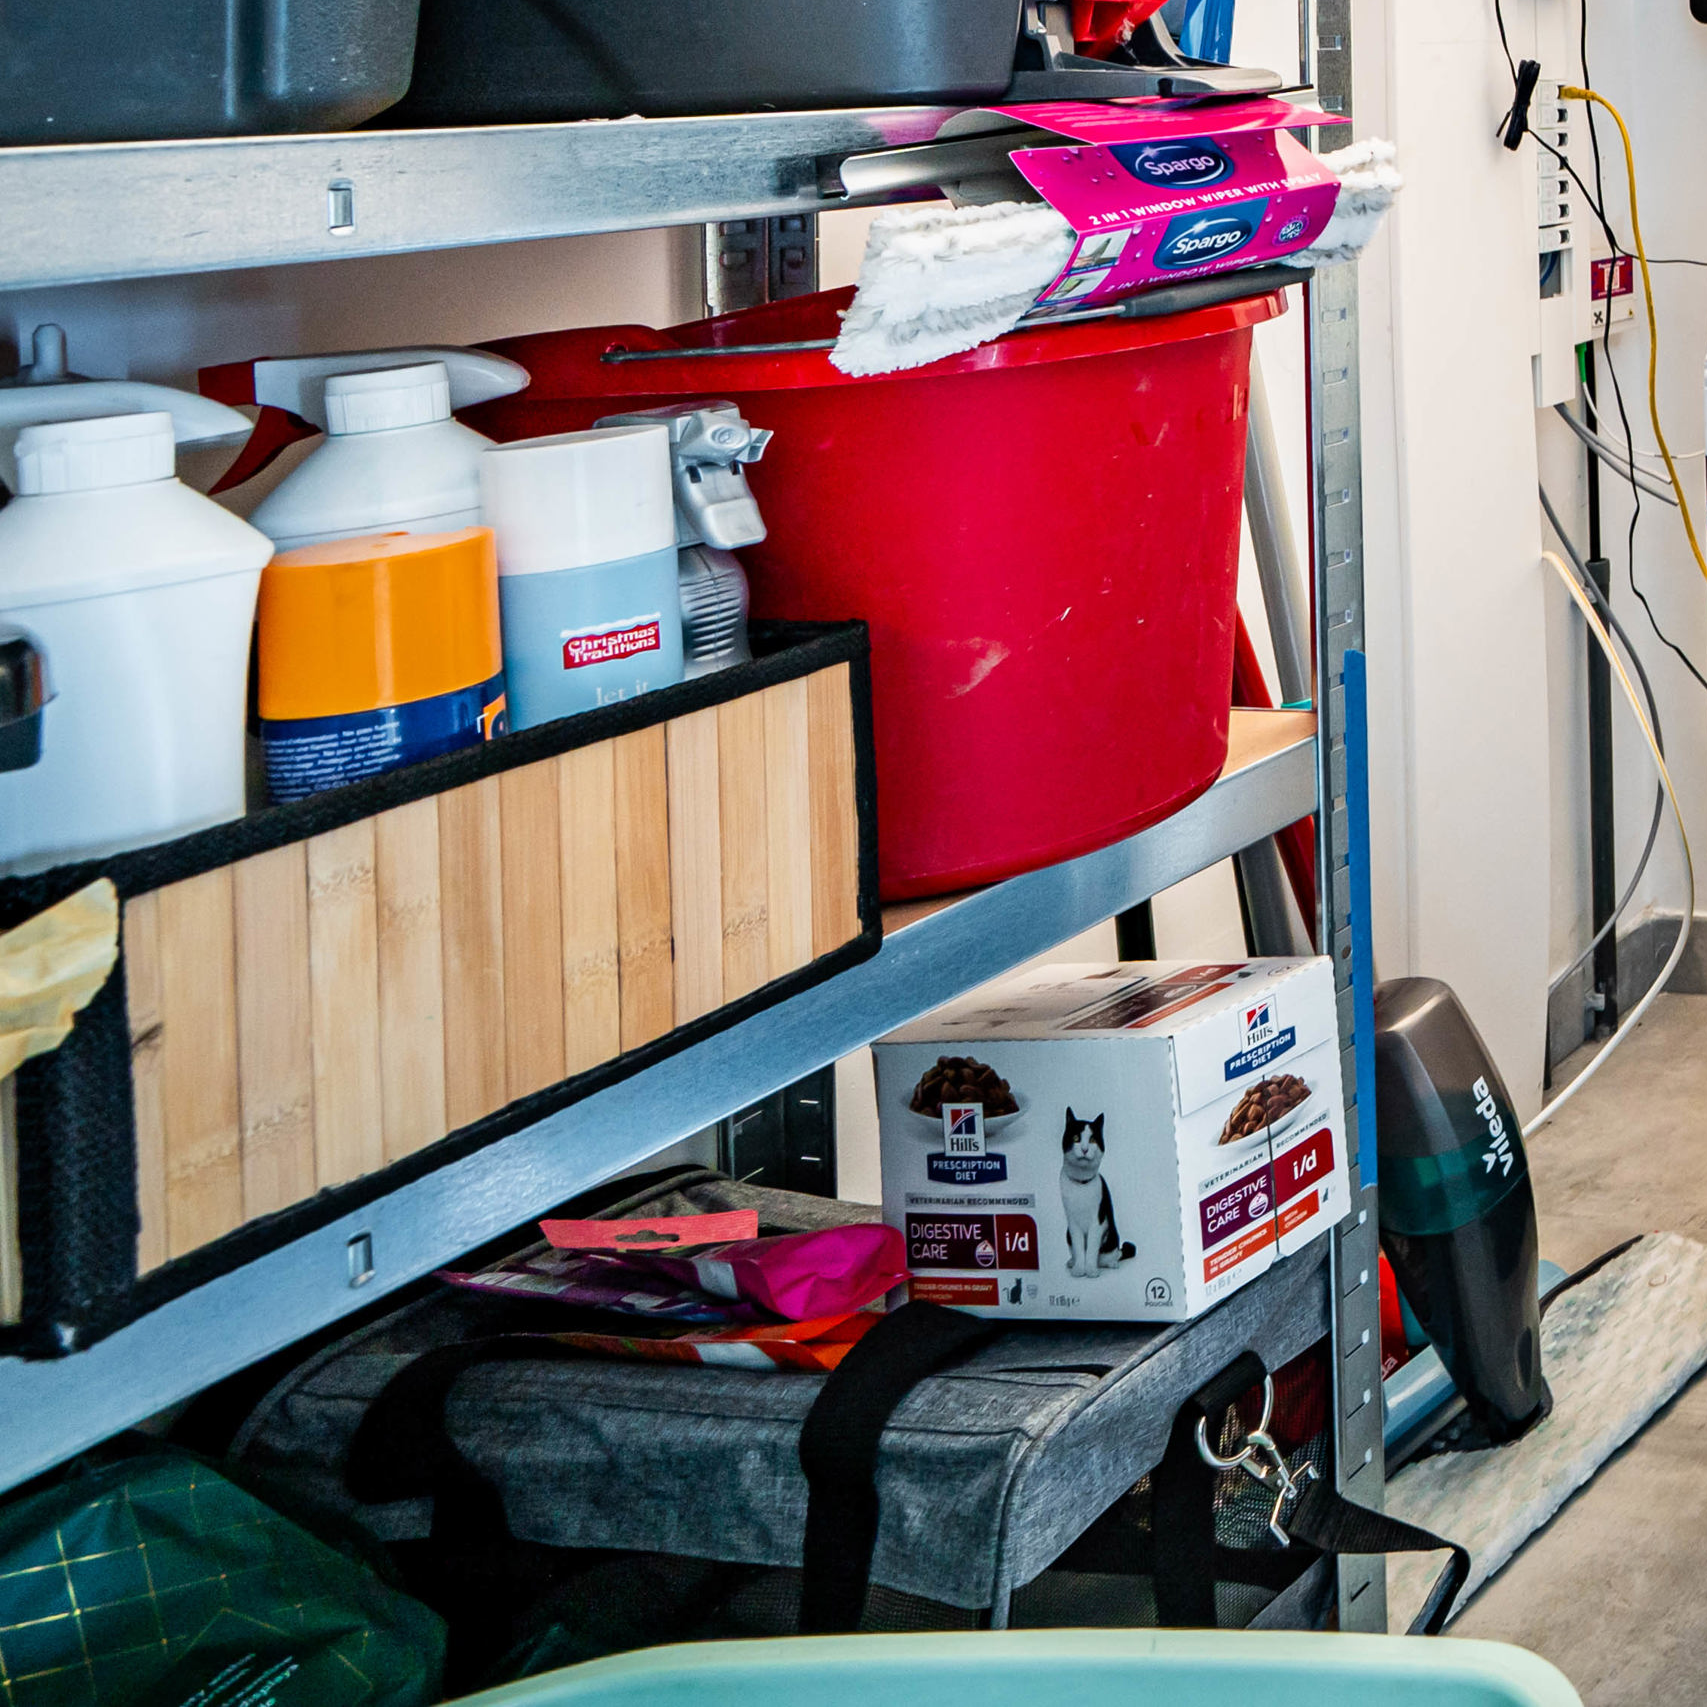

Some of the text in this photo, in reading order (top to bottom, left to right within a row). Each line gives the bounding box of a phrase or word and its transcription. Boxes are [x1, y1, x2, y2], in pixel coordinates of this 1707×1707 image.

[1144, 154, 1215, 177] Spargo
[1089, 215, 1101, 226] 2
[1102, 210, 1117, 224] IN
[1130, 197, 1196, 218] WINDOW
[1198, 188, 1244, 204] WIPER
[1246, 180, 1279, 195] WITH
[1173, 230, 1241, 254] Spargo
[568, 627, 656, 652] Christmas
[570, 637, 656, 663] Traditions
[1230, 1034, 1291, 1071] PRESCRIPTION
[1252, 1052, 1272, 1068] DIET
[950, 1137, 980, 1152] Hill's
[932, 1159, 1001, 1171] PRESCRIPTION
[955, 1170, 977, 1181] DIET
[1204, 1152, 1264, 1189] VETERINARIAN
[1293, 1149, 1317, 1181] i/d
[966, 1197, 1030, 1206] RECOMMENDED
[1207, 1175, 1268, 1219] DIGESTIVE
[911, 1222, 982, 1240] DIGESTIVE
[1207, 1207, 1240, 1233] CARE
[911, 1243, 948, 1260] CARE
[1005, 1231, 1030, 1252] i/d
[1151, 1286, 1165, 1299] 12
